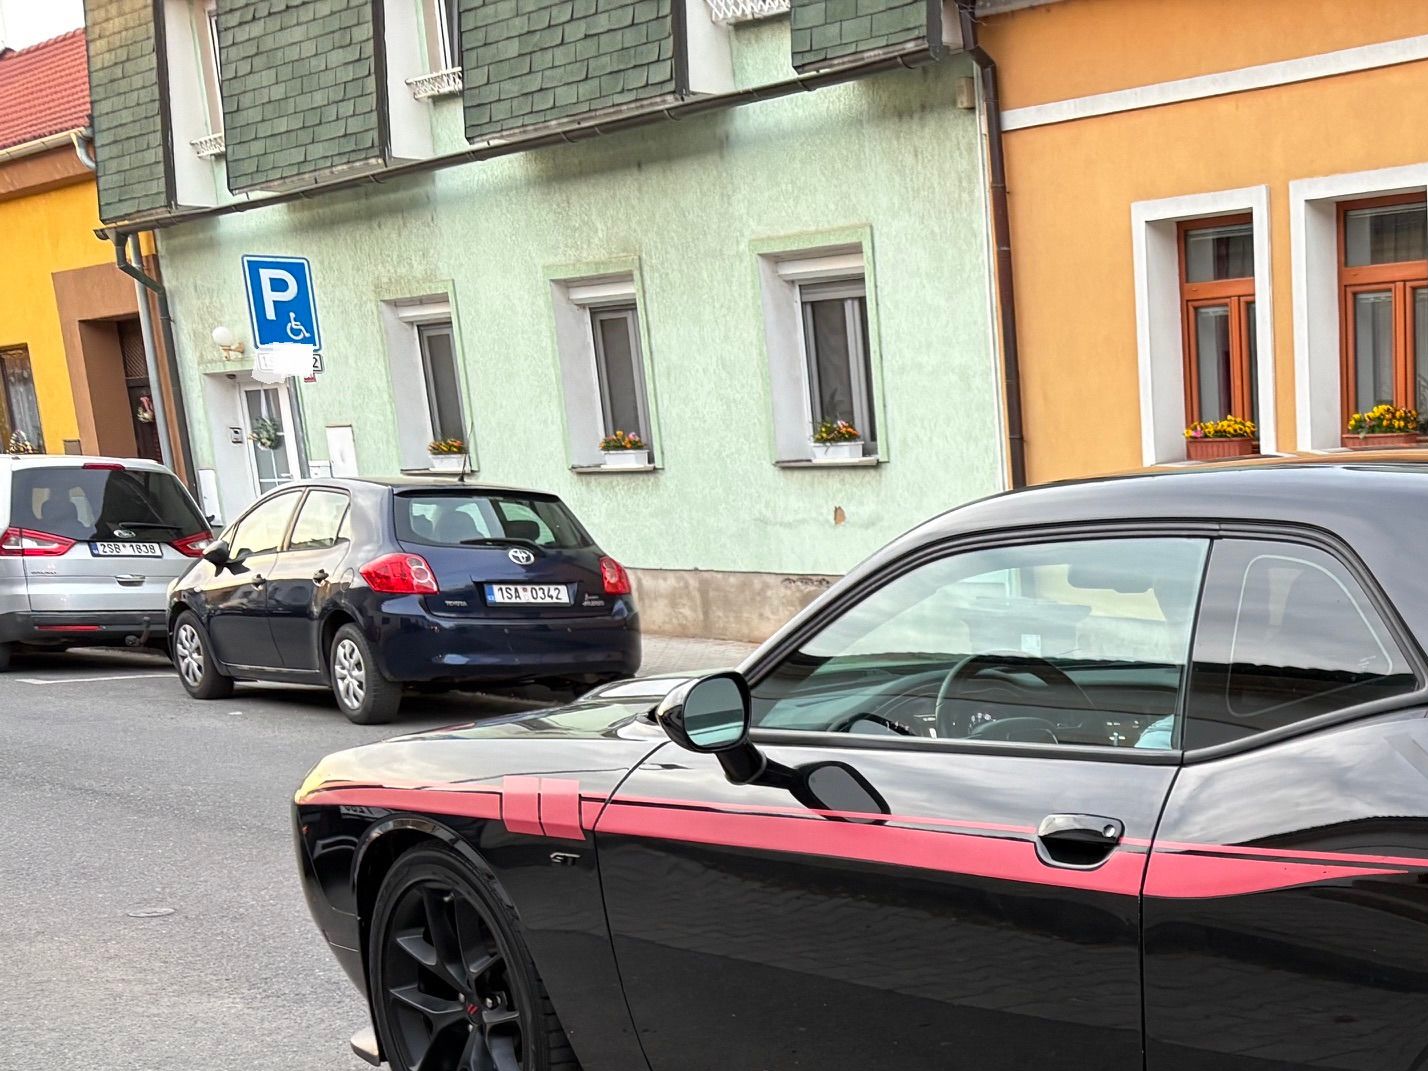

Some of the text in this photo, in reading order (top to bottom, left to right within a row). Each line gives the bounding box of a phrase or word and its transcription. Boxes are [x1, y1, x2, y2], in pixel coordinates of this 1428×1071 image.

[259, 268, 298, 320] P
[100, 543, 121, 554] 2SB
[498, 587, 562, 600] 1SA 0342
